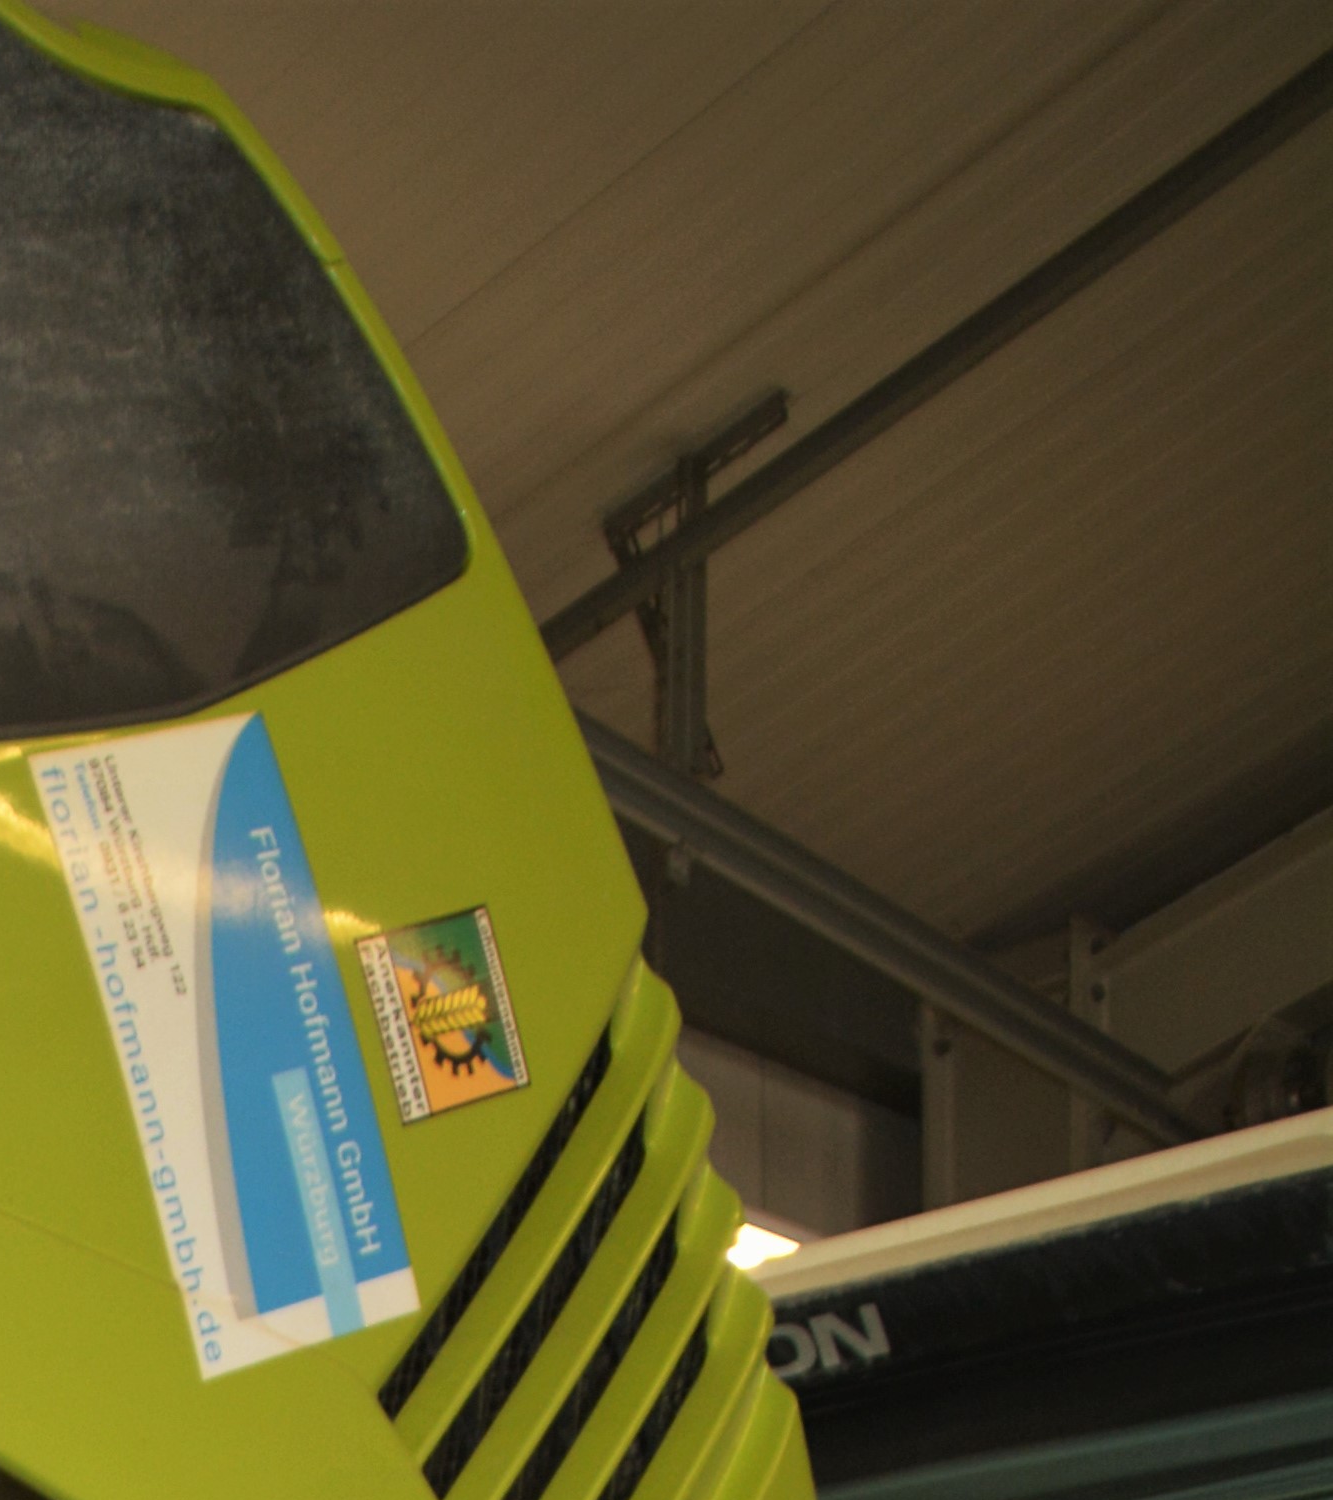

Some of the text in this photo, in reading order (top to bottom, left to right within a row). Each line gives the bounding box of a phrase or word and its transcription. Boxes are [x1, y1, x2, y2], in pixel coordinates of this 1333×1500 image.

[88, 758, 113, 813] 97084
[109, 817, 142, 909] Würzburg
[104, 754, 188, 997] Unterer Kirchbergweg 122
[123, 920, 138, 941] 23
[249, 825, 381, 1256] Florian Hofmann GmbH
[360, 944, 413, 1118] Fachbetrieb
[374, 944, 425, 1112] Anerkannter
[287, 1093, 341, 1268] Würzburg
